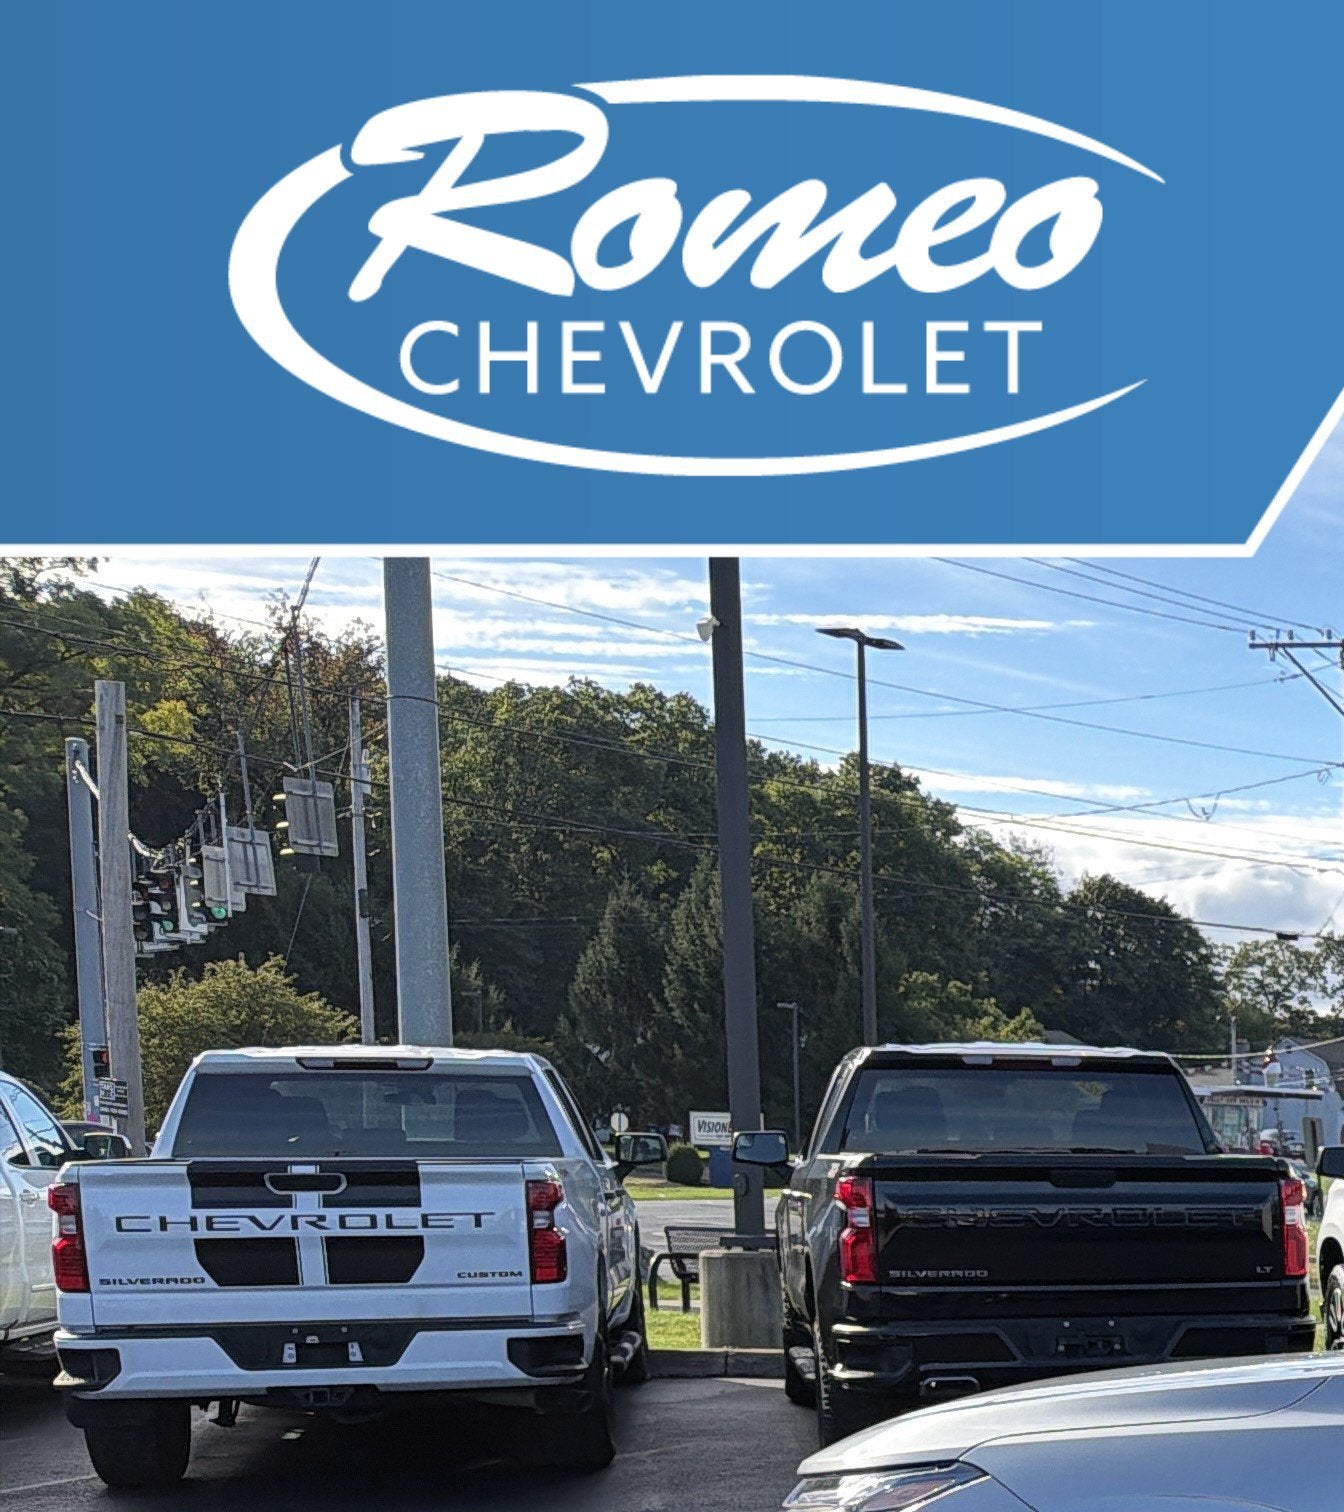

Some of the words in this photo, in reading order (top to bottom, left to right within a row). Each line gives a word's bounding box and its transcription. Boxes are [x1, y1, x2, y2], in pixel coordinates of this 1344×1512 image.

[114, 1211, 497, 1233] CHEVROLET
[903, 1206, 1255, 1229] CHEVROLET
[456, 1270, 523, 1279] CUSTOM
[888, 1268, 989, 1278] SILVERADO
[1255, 1265, 1274, 1274] LT
[99, 1275, 206, 1286] SILVERADO
